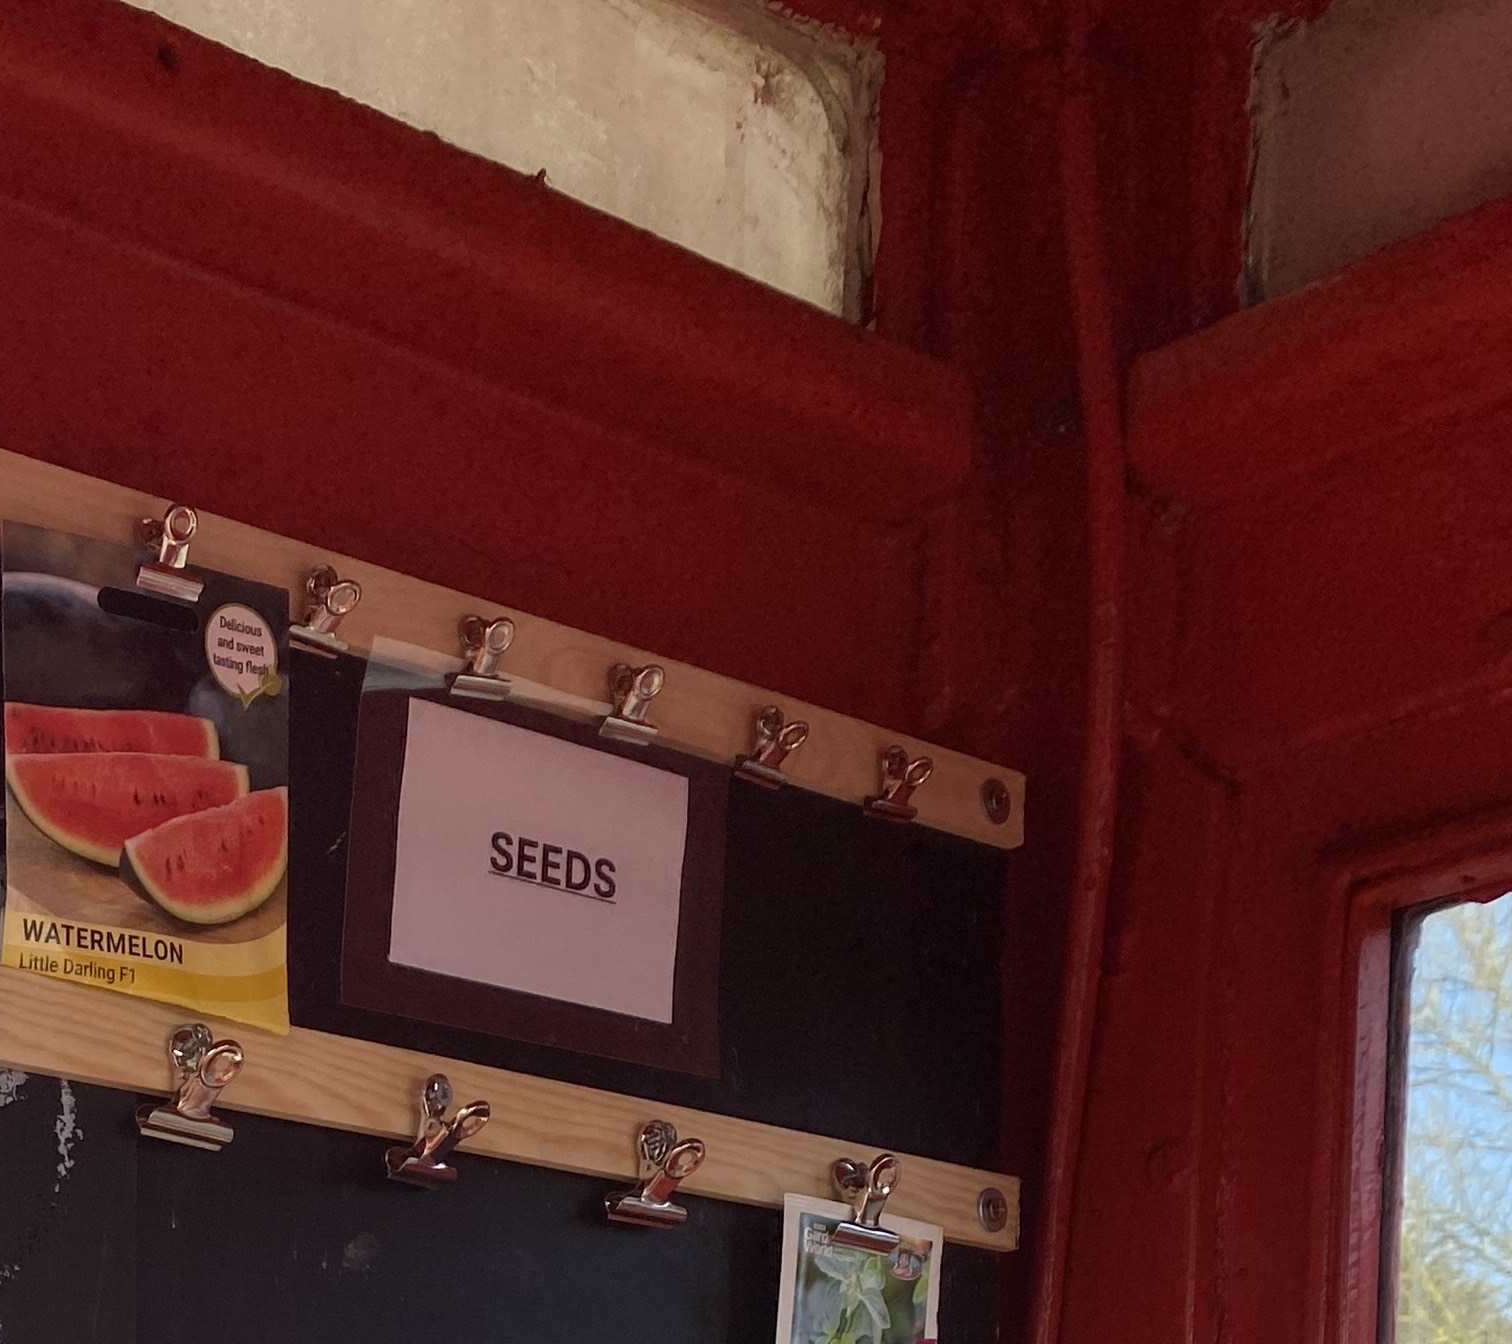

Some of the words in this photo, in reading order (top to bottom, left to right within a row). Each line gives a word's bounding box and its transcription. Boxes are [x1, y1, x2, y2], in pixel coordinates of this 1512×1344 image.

[219, 615, 263, 638] Delicious
[217, 637, 234, 651] and
[236, 641, 265, 657] sweet
[213, 653, 244, 675] tasting
[490, 831, 617, 899] SEEDS
[22, 918, 185, 964] WATERMELON
[19, 953, 59, 975] Little
[63, 957, 116, 984] Darling
[119, 965, 136, 983] F1
